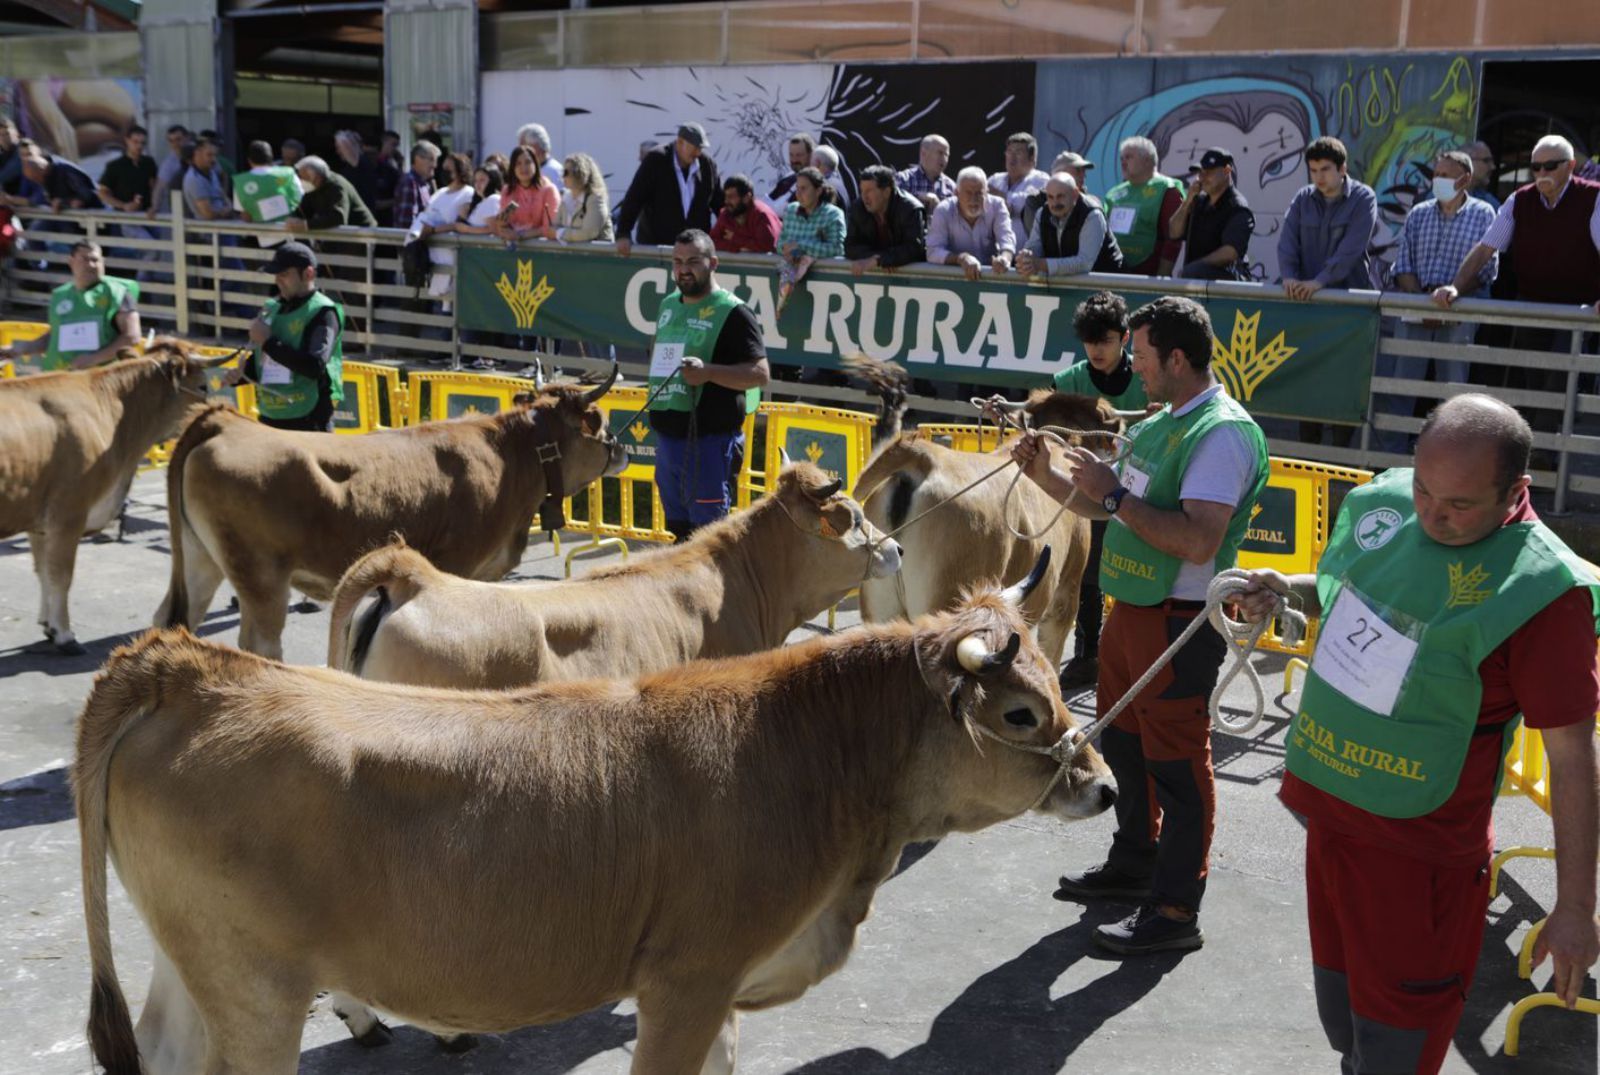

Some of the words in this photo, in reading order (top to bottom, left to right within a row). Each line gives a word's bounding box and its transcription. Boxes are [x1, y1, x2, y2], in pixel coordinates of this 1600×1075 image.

[803, 280, 1075, 375] RURAL
[662, 347, 675, 360] 38
[1111, 553, 1157, 581] RURAL
[1346, 616, 1383, 653] 27
[1298, 711, 1337, 753] CAJA
[1340, 739, 1427, 782] RURAL
[1307, 742, 1361, 778] ASTURIAS
